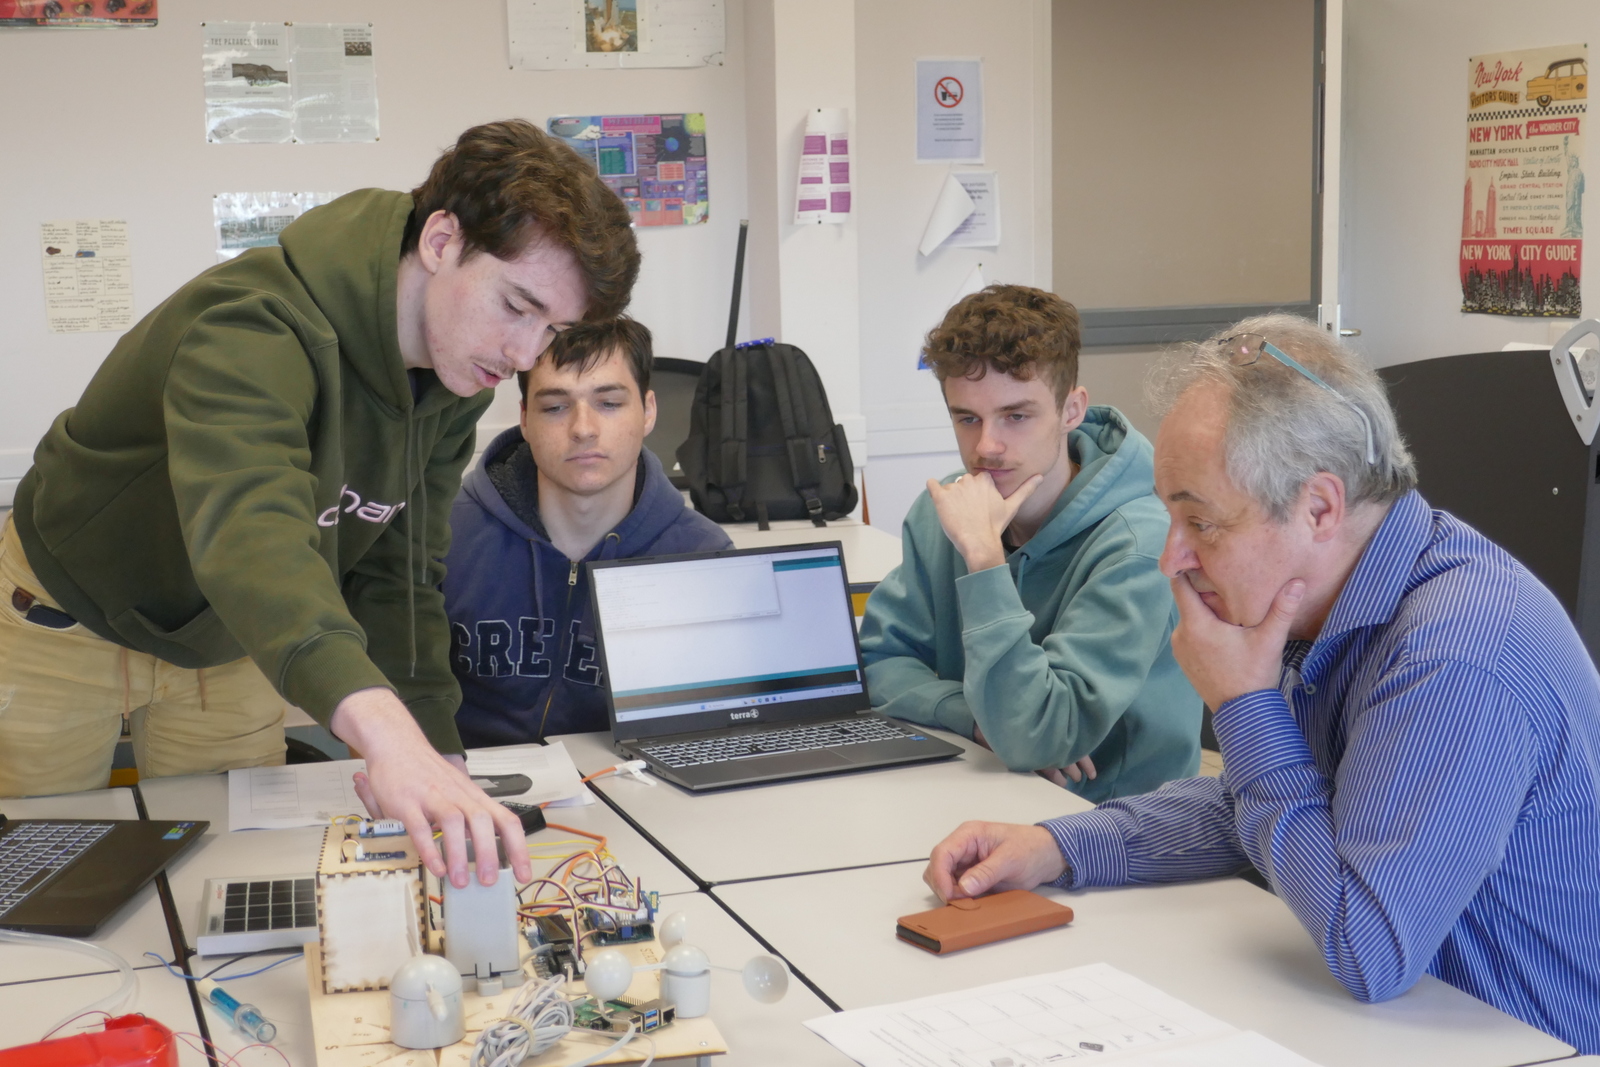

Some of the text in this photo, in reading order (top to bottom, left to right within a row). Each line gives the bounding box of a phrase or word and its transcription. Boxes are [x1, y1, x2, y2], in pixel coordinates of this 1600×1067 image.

[1474, 60, 1523, 88] New York
[1499, 91, 1518, 104] GUIDE
[1563, 121, 1577, 131] CITY
[1470, 124, 1523, 143] NEW YORK
[1469, 148, 1496, 156] MANHATTAN
[1499, 146, 1537, 154] ROCKEFELLER
[1503, 226, 1554, 236] TIMES SQUARE
[1462, 244, 1578, 261] NEW YORK CITY GUIDE
[730, 712, 751, 721] terra
